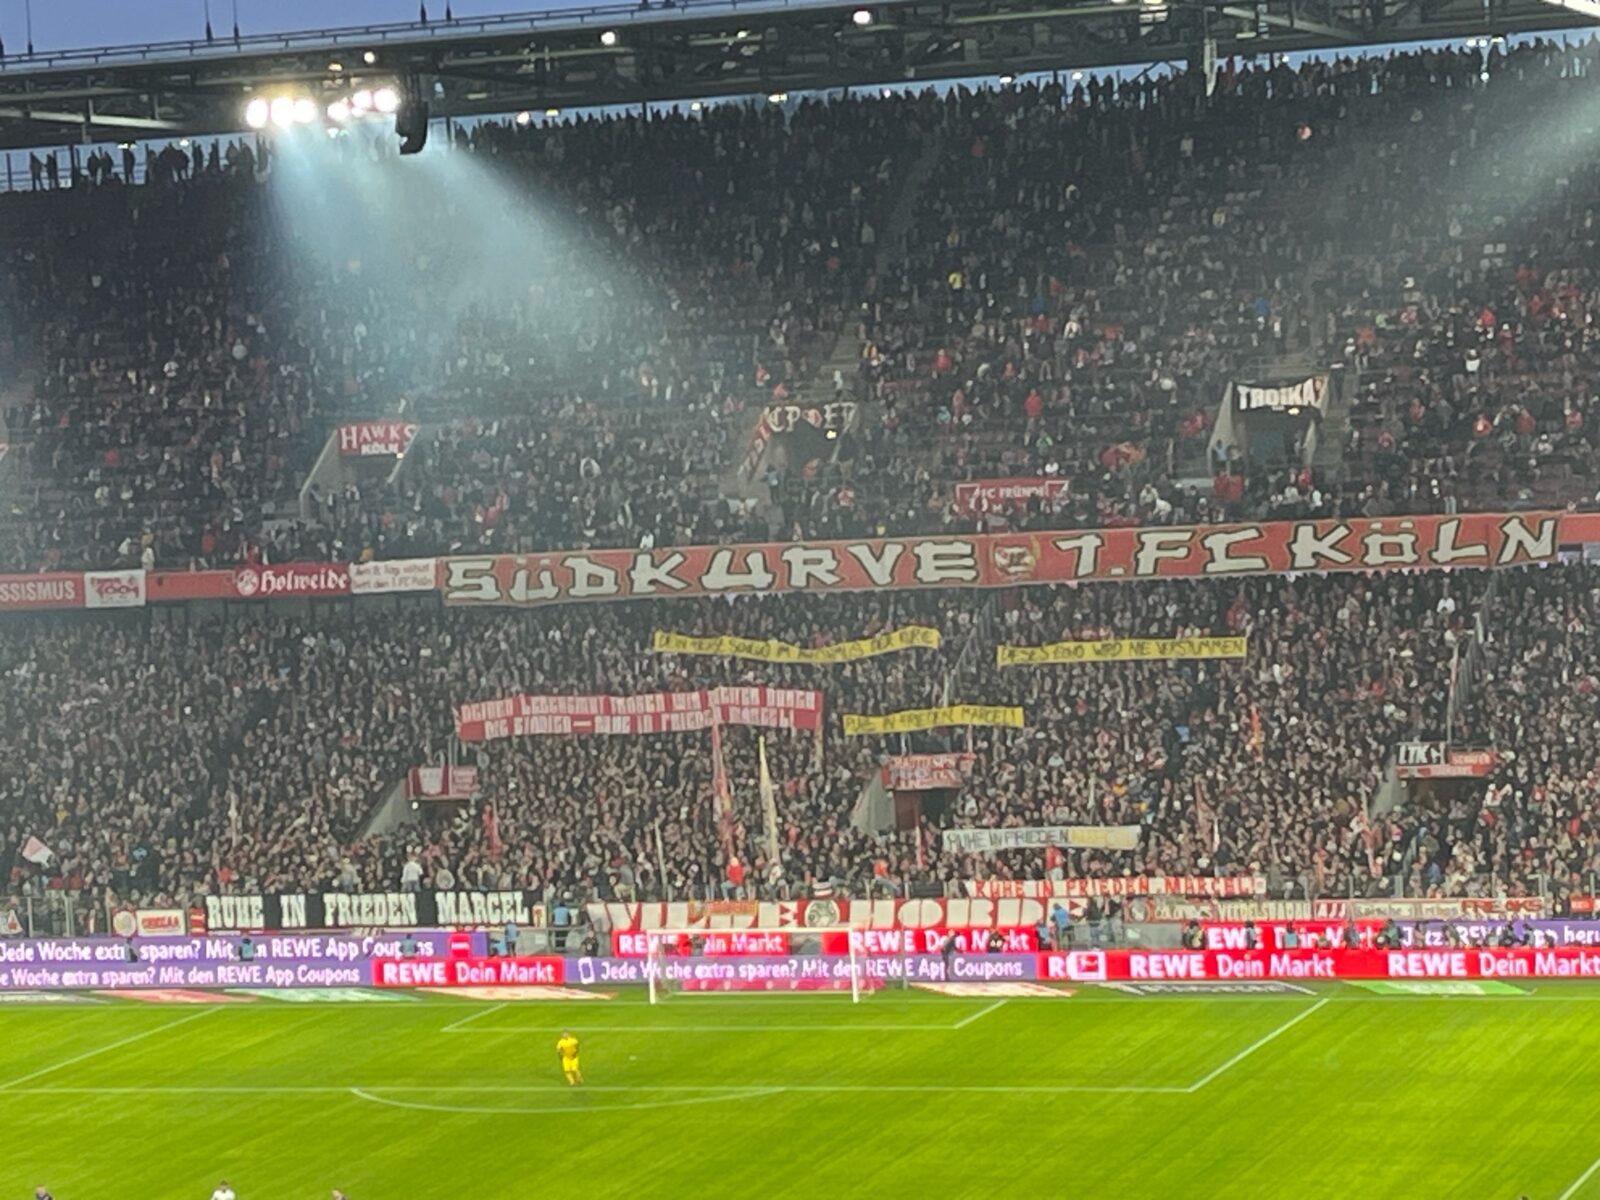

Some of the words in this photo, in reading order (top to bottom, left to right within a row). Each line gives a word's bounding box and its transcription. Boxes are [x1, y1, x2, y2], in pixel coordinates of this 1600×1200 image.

[447, 540, 978, 600] SÜDKURVE
[1292, 517, 1557, 567] KÖLN
[261, 567, 349, 594] Holweide
[975, 879, 1025, 898] RUHE
[205, 893, 265, 930] RUHE
[280, 894, 306, 929] IN
[323, 891, 418, 928] FRIEDEN
[436, 890, 531, 927] MARCEL
[37, 941, 91, 961] Woche
[139, 939, 200, 965] sparen?
[272, 938, 322, 958] REWE
[325, 938, 363, 963] App
[731, 932, 783, 953] Markt
[852, 930, 915, 952] REWE
[11, 967, 59, 986] Woche
[62, 968, 98, 985] extra
[102, 967, 156, 988] sparen?
[159, 966, 185, 984] Mit
[188, 965, 214, 984] den
[217, 965, 262, 984] REWE
[265, 965, 294, 988] App
[298, 964, 360, 988] Coupons
[383, 962, 447, 984] REWE
[456, 958, 497, 983] Dein
[501, 957, 555, 983] Markt
[601, 961, 637, 980] Jede
[695, 961, 736, 979] extra
[739, 960, 799, 984] sparen?
[866, 957, 915, 978] REWE
[953, 957, 1024, 981] Coupons
[1129, 954, 1206, 978] REWE
[1217, 953, 1264, 977] Dein
[1270, 953, 1336, 977] Markt
[1388, 952, 1467, 977] REWE
[1478, 952, 1529, 976] Dein
[1535, 951, 1600, 976] Markt
